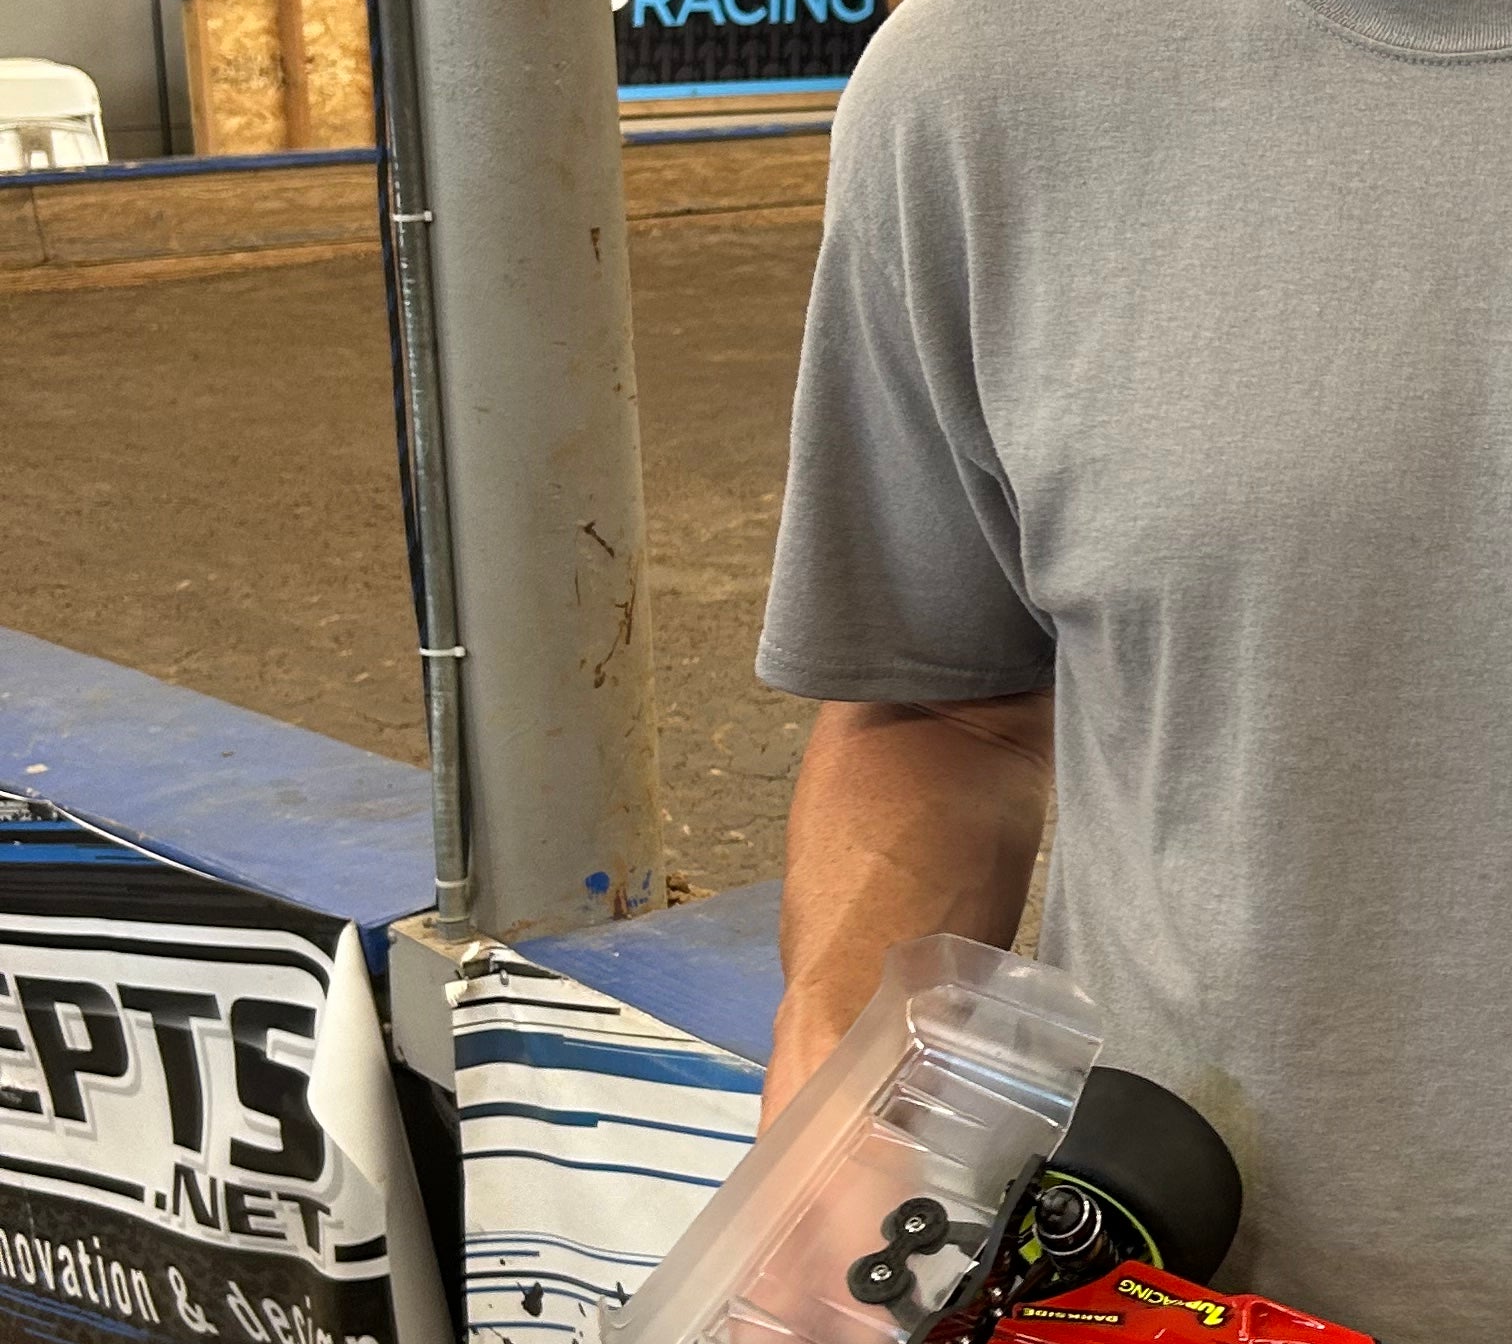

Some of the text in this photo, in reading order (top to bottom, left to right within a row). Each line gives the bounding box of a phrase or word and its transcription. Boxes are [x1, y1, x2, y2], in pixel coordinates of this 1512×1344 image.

[154, 1162, 332, 1254] .NET
[0, 1227, 160, 1324] novation
[168, 1265, 219, 1335] &
